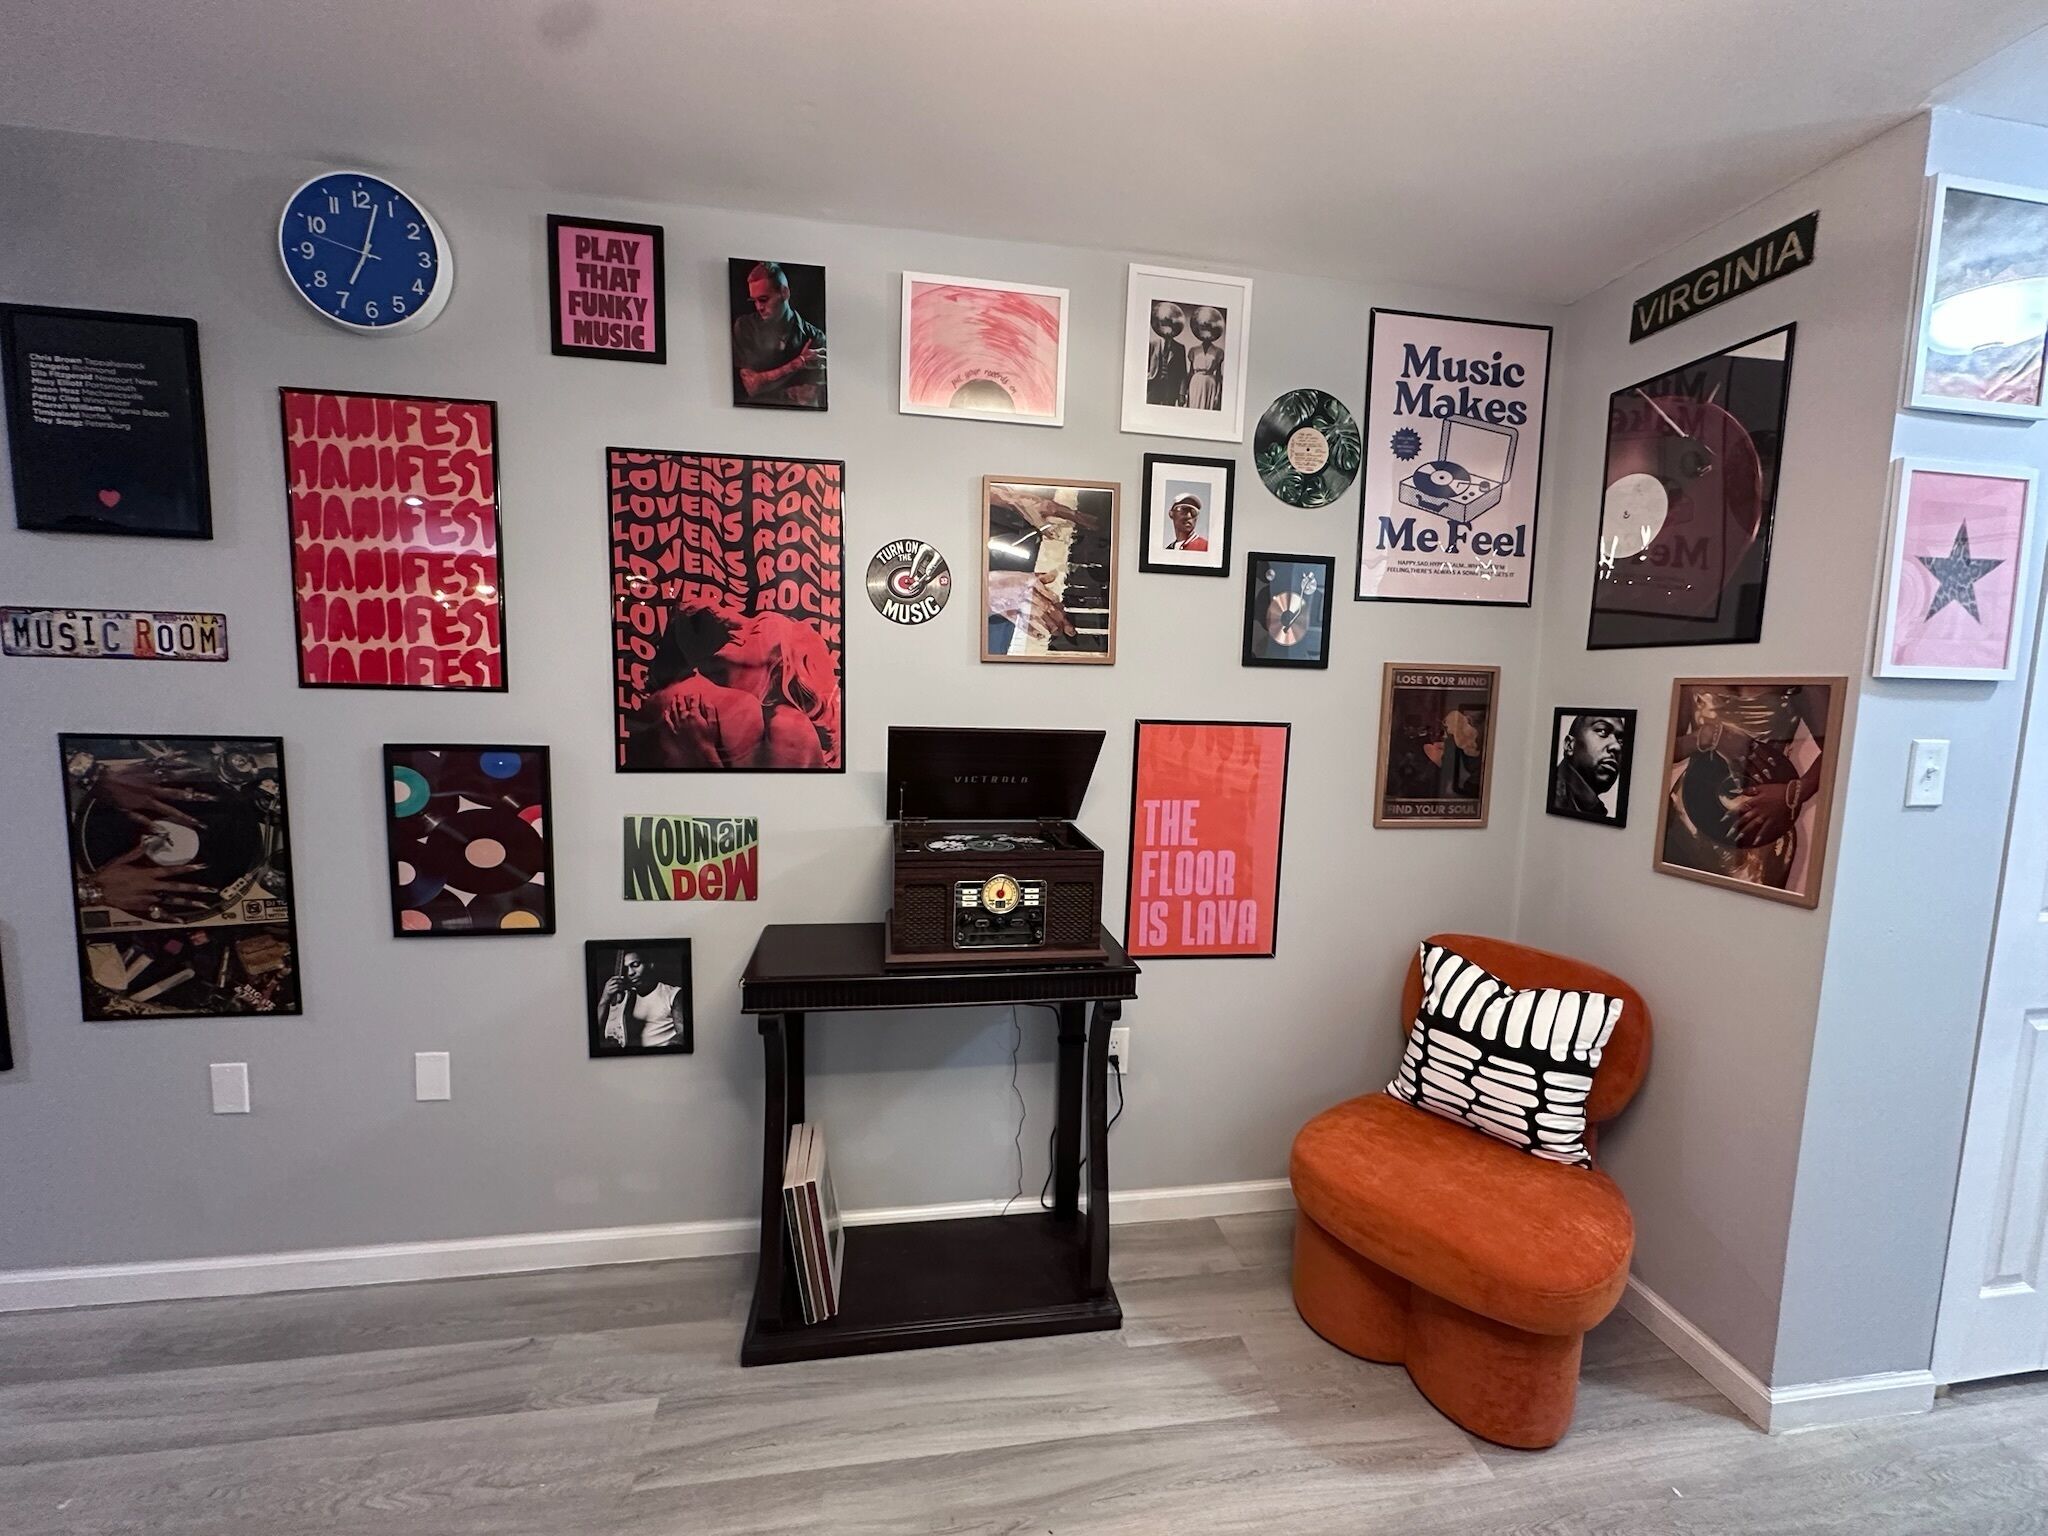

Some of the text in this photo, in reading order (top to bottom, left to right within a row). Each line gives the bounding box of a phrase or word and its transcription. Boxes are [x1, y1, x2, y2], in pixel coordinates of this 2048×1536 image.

[329, 196, 340, 214] 11
[352, 190, 371, 209] 12
[388, 201, 393, 218] 1
[307, 215, 326, 234] 10
[406, 223, 420, 241] 2
[301, 241, 315, 260] 9
[418, 251, 432, 268] 3
[575, 234, 640, 265] PLAY
[314, 270, 328, 288] 8
[412, 278, 424, 295] 4
[576, 262, 641, 293] THAT
[1638, 230, 1805, 331] VIRGINIA
[336, 291, 350, 309] 7
[365, 301, 379, 319] 6
[393, 296, 406, 314] 5
[568, 290, 648, 322] FUNKY
[573, 319, 645, 350] MUSIC
[29, 353, 52, 362] Chris
[54, 355, 82, 364] Brown
[1400, 343, 1525, 388] Music
[1393, 380, 1528, 425] Makes
[612, 461, 743, 507] LOVERS
[752, 464, 840, 510] ROCK
[613, 491, 841, 541] LOVERS ROCK
[614, 516, 840, 577] LOVERS ROCK
[1376, 515, 1525, 557] Me Feel
[615, 538, 840, 594] LOVERS ROCK
[876, 541, 919, 564] TURN ON
[898, 553, 912, 561] THE
[755, 579, 840, 618] ROCK
[882, 596, 941, 624] MUSIC
[12, 616, 217, 654] MUSIC ROOM
[1396, 675, 1487, 686] LOSE YOUR MIND
[1143, 799, 1200, 846] THE
[1388, 804, 1476, 814] FIND YOUR SOUL
[1140, 850, 1236, 897] FLOOR
[1138, 899, 1258, 947] IS LAVA
